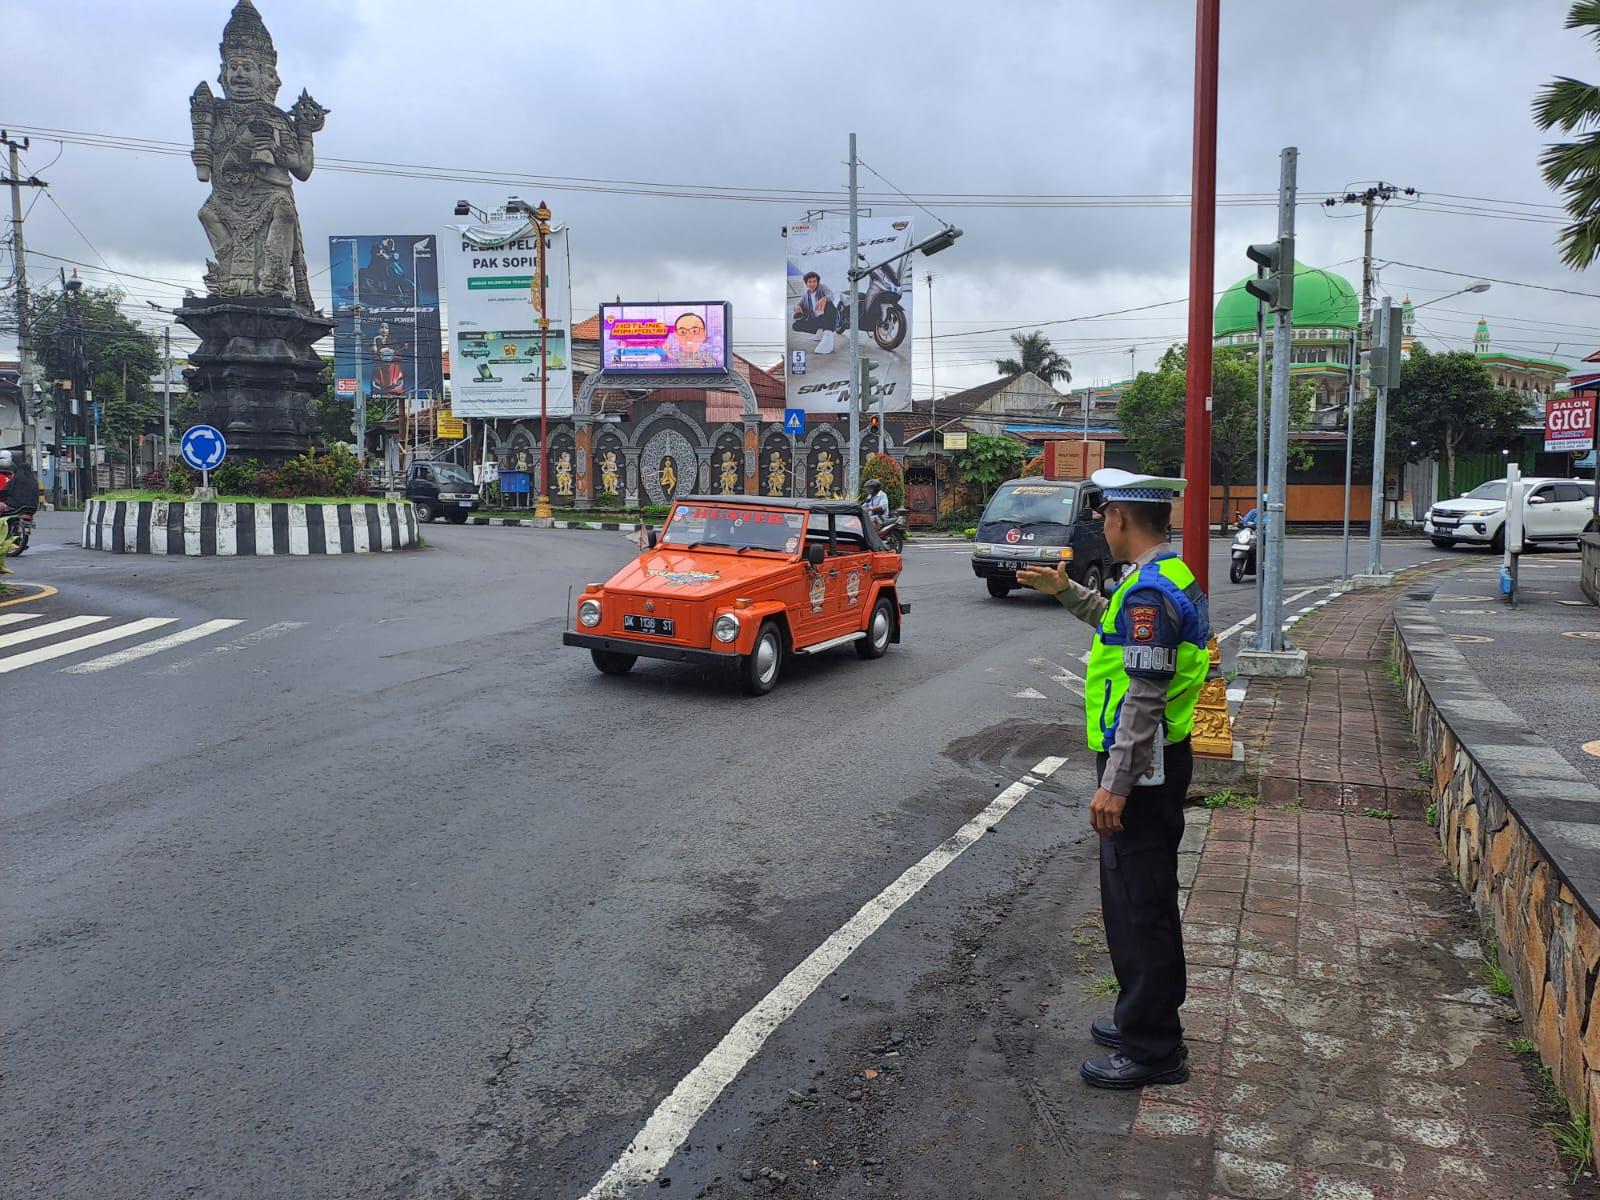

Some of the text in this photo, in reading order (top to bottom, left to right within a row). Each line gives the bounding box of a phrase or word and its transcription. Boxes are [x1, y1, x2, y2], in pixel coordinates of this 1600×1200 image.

[473, 258, 498, 269] PAK
[796, 352, 802, 361] 5
[338, 380, 346, 390] 5
[797, 380, 851, 395] SIMP
[837, 382, 897, 403] MXI
[1552, 400, 1590, 410] SALON
[1548, 408, 1593, 431] GIGI
[1021, 533, 1035, 541] LG
[624, 615, 634, 627] DK
[663, 620, 672, 631] ST
[1123, 645, 1177, 672] ATROLI
